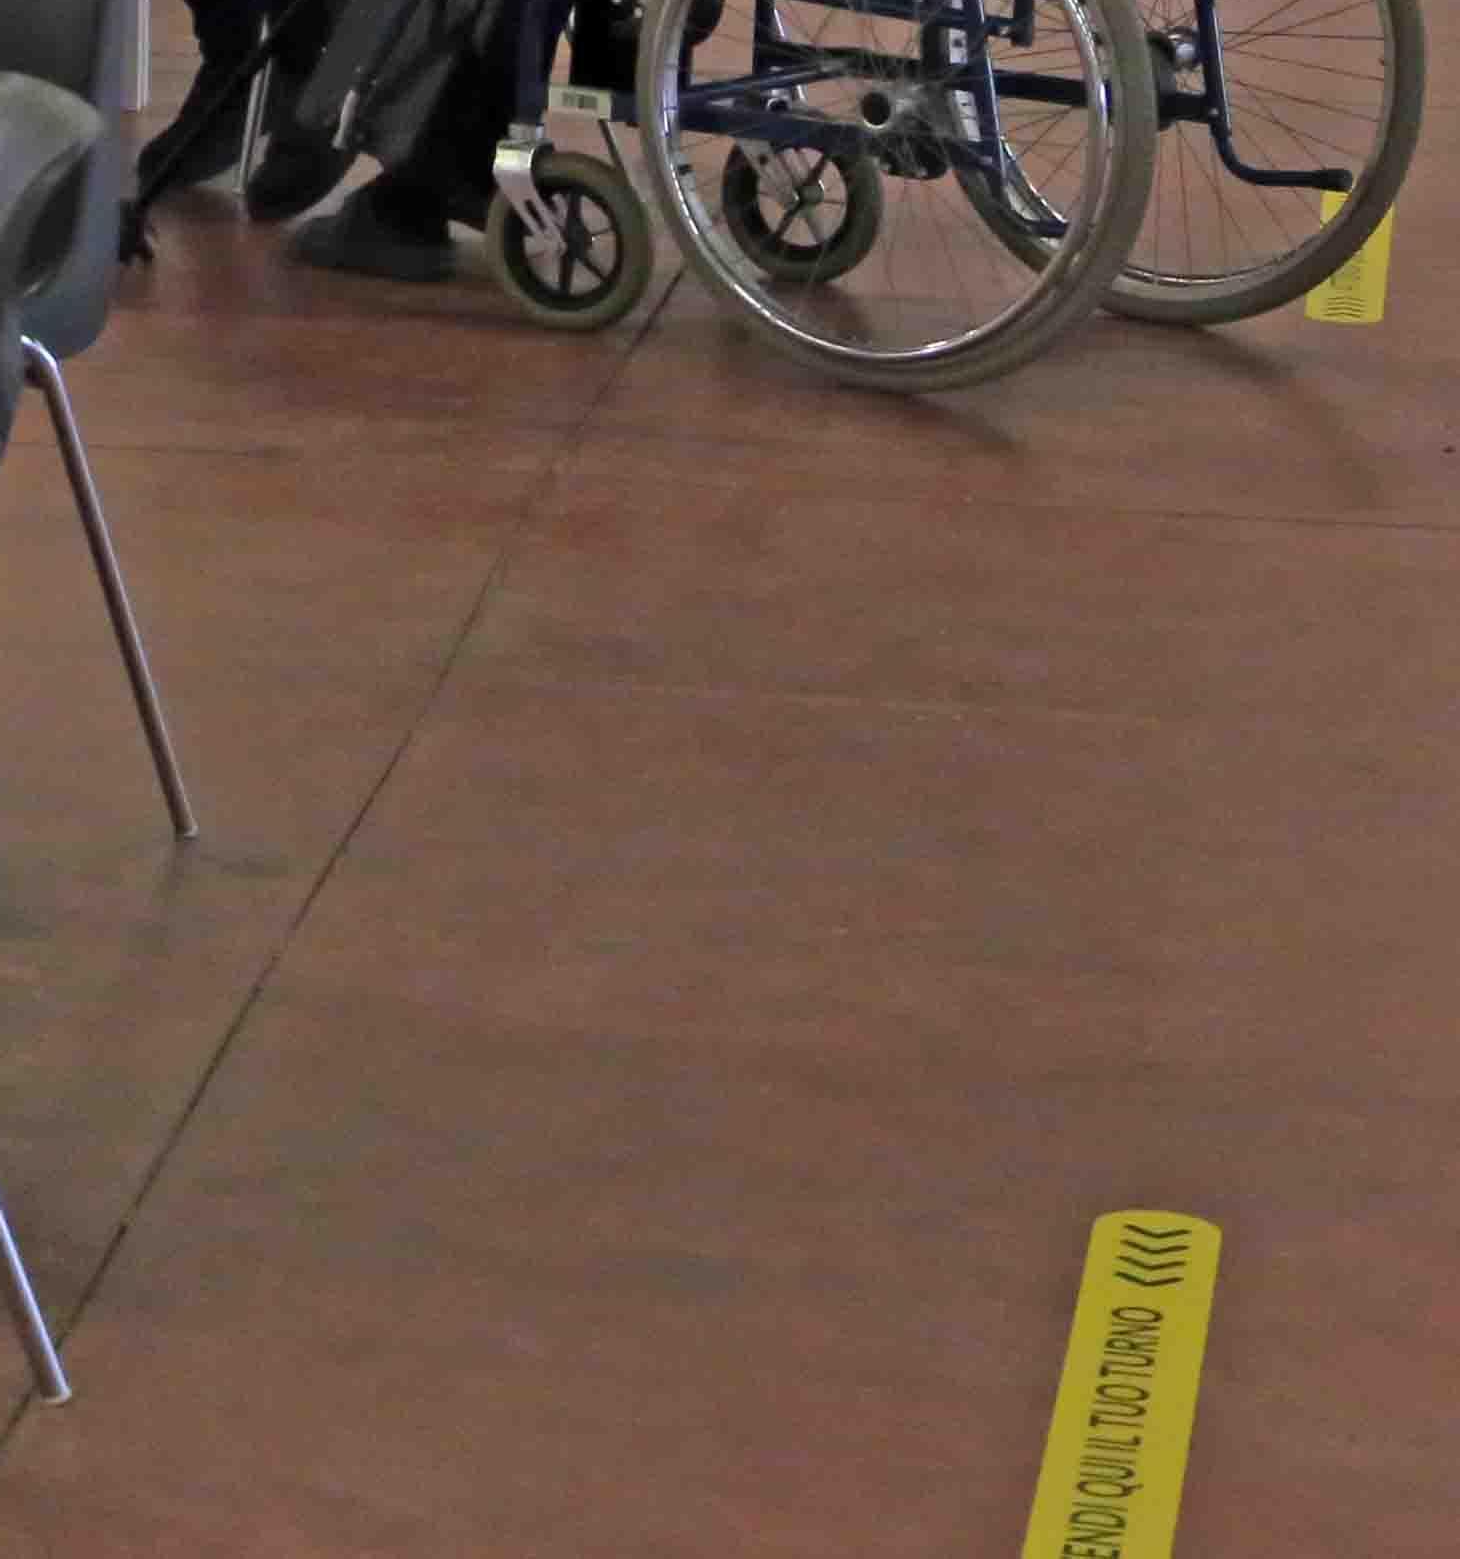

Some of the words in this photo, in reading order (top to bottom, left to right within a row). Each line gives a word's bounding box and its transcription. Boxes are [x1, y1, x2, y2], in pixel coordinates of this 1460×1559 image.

[1098, 1306, 1164, 1379] TURNO
[1088, 1383, 1150, 1429] TUO
[1083, 1435, 1142, 1453] IL
[1077, 1455, 1145, 1499] QUI
